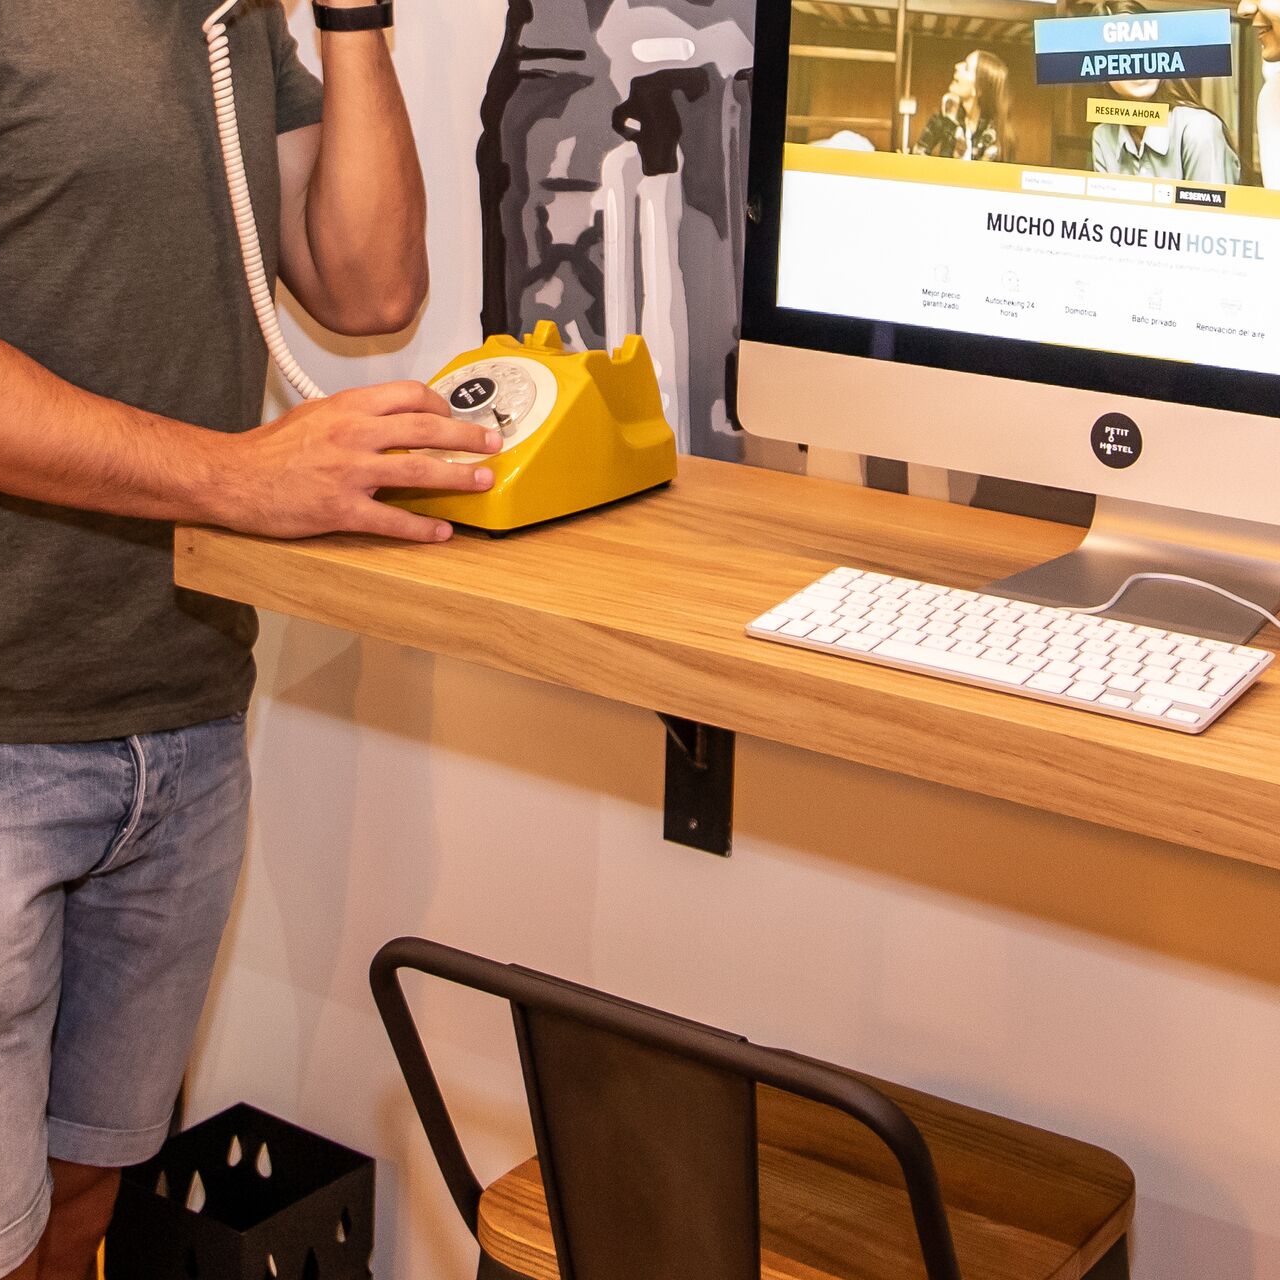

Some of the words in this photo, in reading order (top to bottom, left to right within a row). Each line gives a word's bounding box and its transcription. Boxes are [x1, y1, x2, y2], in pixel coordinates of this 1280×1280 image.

[1103, 20, 1159, 43] GRAN
[1080, 51, 1186, 77] APERTURA
[1095, 106, 1130, 117] RESERVA
[1132, 109, 1161, 119] AHORA
[1179, 190, 1211, 202] RESERVA
[1211, 193, 1222, 203] YA
[986, 212, 1055, 237] MUCHO
[1061, 218, 1103, 242] MÁS
[1110, 226, 1148, 248] QUE
[1154, 230, 1181, 251] UN
[1186, 233, 1265, 261] HOSTEL
[1099, 442, 1133, 455] HOSTEL
